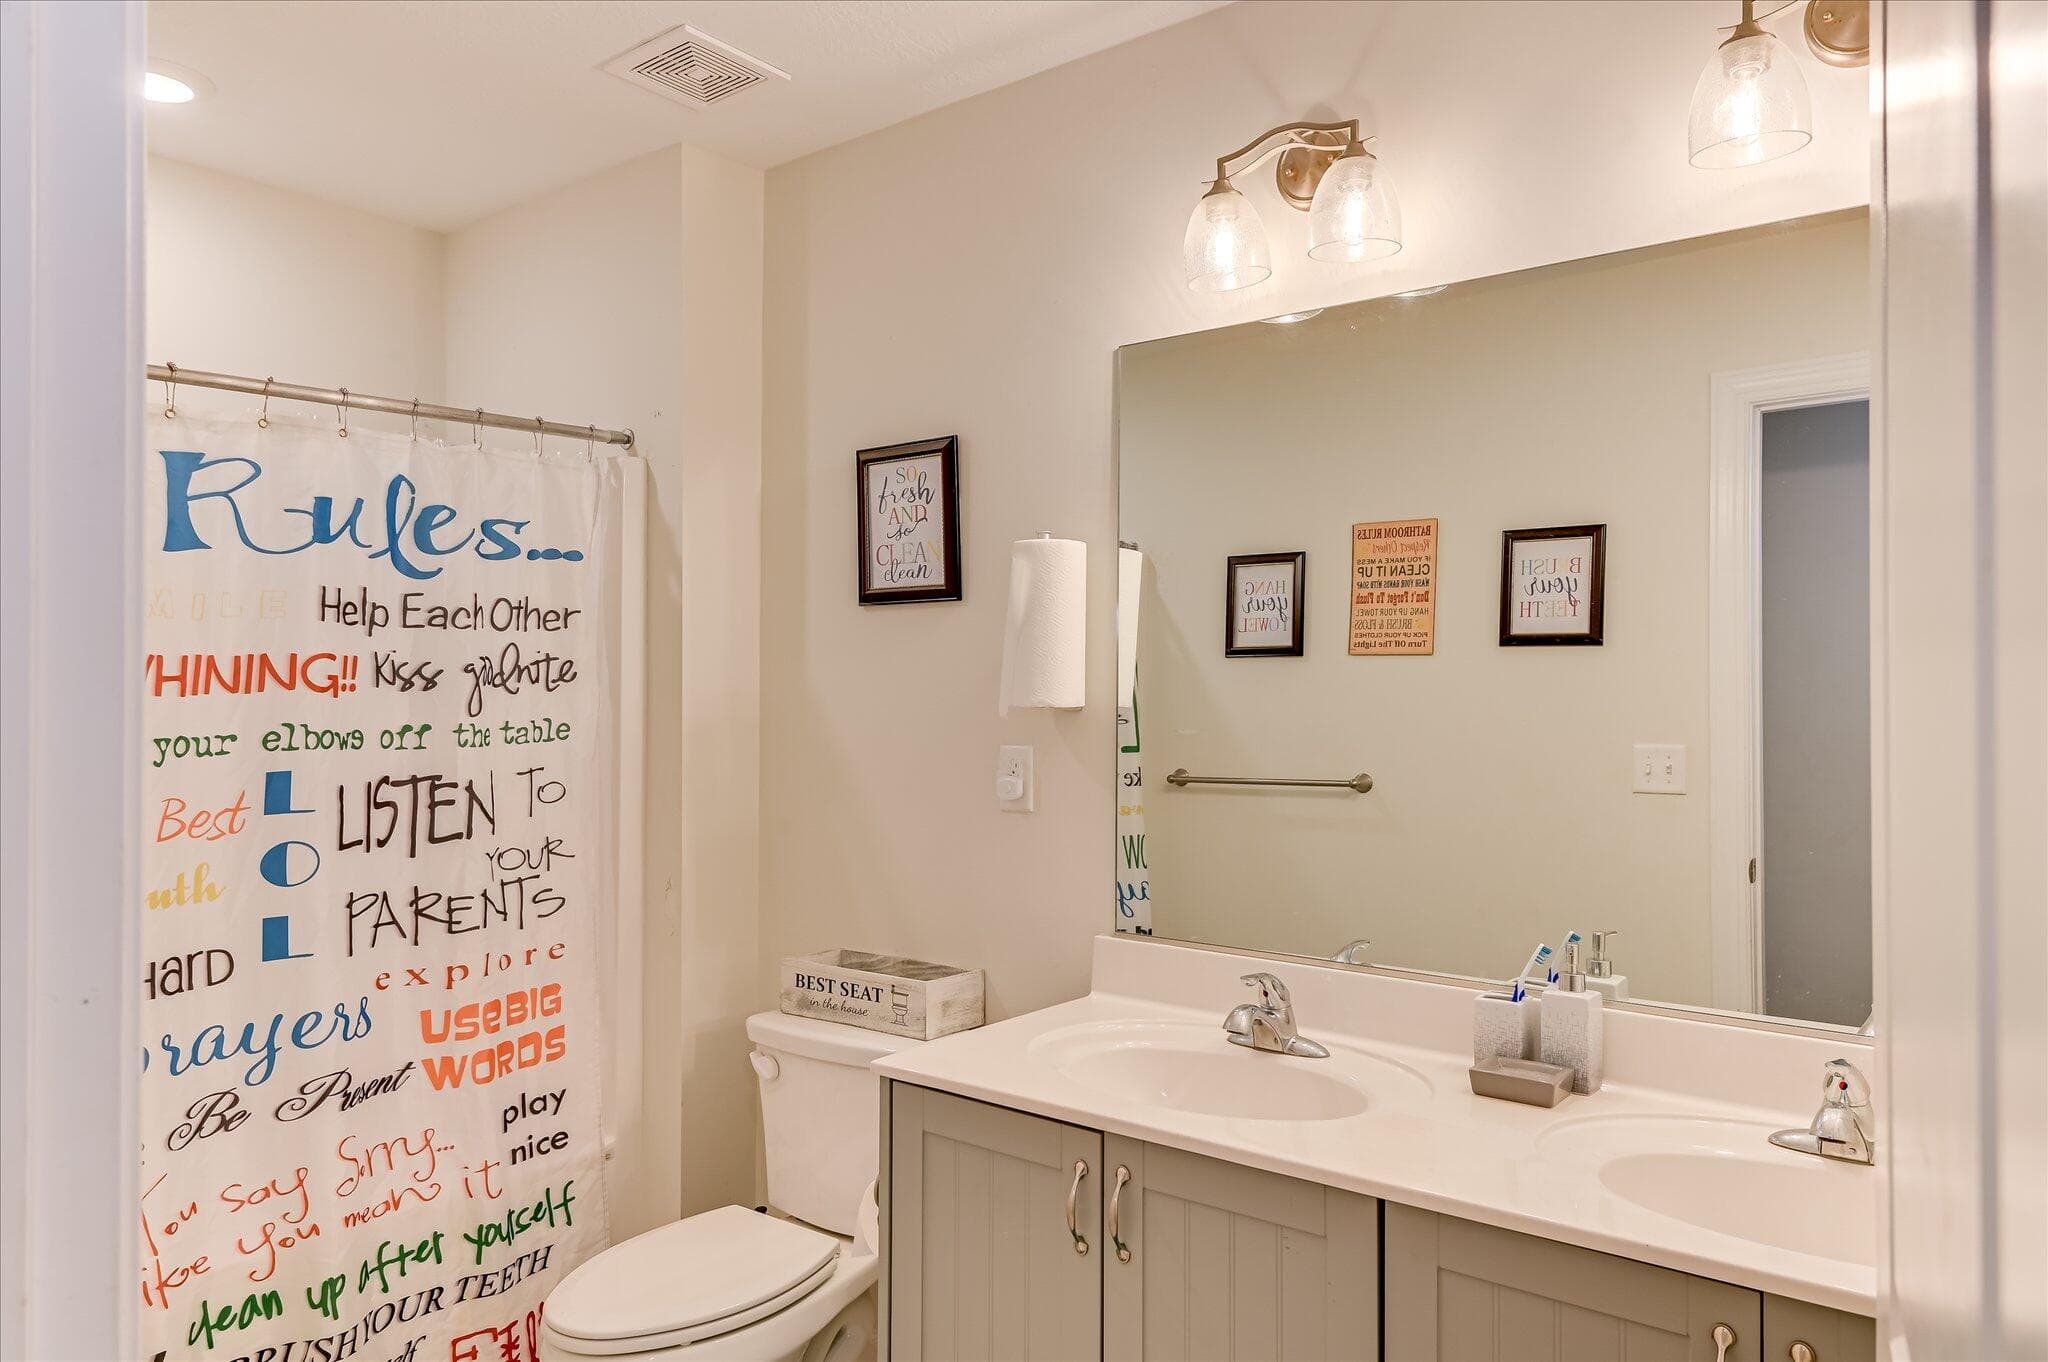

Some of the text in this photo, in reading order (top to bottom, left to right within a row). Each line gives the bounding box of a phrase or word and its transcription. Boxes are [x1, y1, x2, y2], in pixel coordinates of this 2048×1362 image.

[878, 471, 935, 514] fresh
[896, 465, 917, 484] SO
[887, 517, 928, 541] so
[888, 505, 927, 525] AND
[876, 539, 941, 566] CLEAN
[884, 557, 932, 583] clean
[320, 586, 581, 636] Help Each Other
[144, 652, 358, 698] HINING!!
[374, 650, 444, 692] Kiss
[153, 734, 238, 767] your
[380, 724, 432, 750] off
[453, 723, 490, 748] the
[500, 718, 571, 745] table
[157, 790, 251, 842] Best
[337, 769, 496, 858] LISTEN
[485, 836, 576, 881] YOUR
[346, 875, 566, 956] PARENTS
[375, 941, 566, 990] explore
[795, 973, 884, 1003] BEST SEAT
[810, 997, 869, 1017] in the house
[143, 996, 373, 1087] rayers
[421, 1024, 566, 1091] WORDS
[168, 1061, 416, 1151] Be Present
[503, 1088, 567, 1134] play
[511, 1132, 570, 1165] nice
[220, 1167, 309, 1224] say
[344, 1182, 442, 1228] mean
[463, 1161, 503, 1200] it
[188, 1180, 576, 1349] clean up after yourself
[361, 1285, 446, 1345] YOUR
[453, 1244, 555, 1305] TEETH
